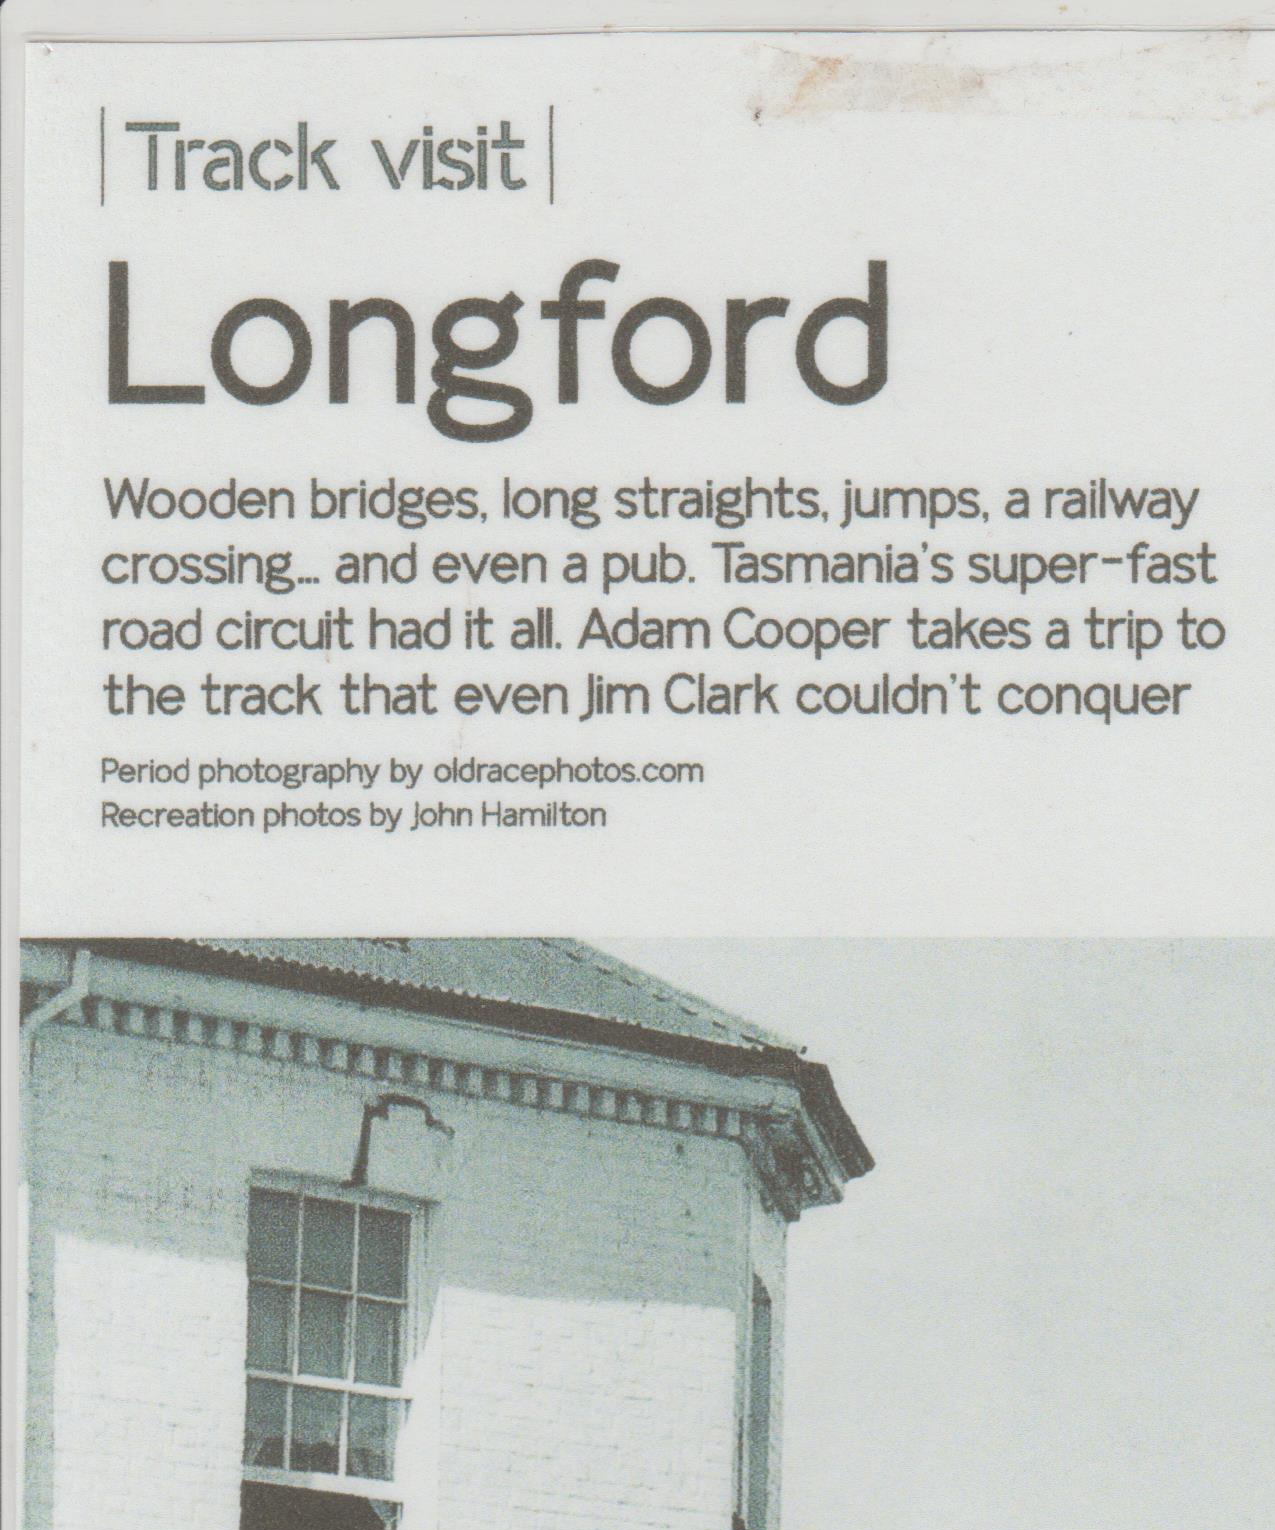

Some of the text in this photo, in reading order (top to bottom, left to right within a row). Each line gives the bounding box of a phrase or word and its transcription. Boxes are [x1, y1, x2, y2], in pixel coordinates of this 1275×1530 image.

[125, 122, 528, 191] Track visit
[108, 259, 888, 443] Longford
[104, 477, 1199, 530] Wooden bridges, long straights, jumps, a railway
[336, 542, 417, 584] and
[432, 552, 547, 584] even
[563, 553, 587, 583] a
[603, 542, 695, 595] pub.
[969, 541, 1218, 594] super-fast
[103, 607, 1225, 660] road circuit had it all. Adam Cooper takes a trip to
[103, 674, 185, 715] the
[201, 673, 322, 715] track
[340, 673, 437, 715] that
[454, 684, 568, 715] even
[579, 673, 649, 722] Jim
[665, 673, 779, 715] Clark
[998, 683, 1191, 725] conquer
[102, 757, 703, 789] Period photography by oldracephotos.com
[102, 801, 606, 833] Recreation photos by John Hamilton
